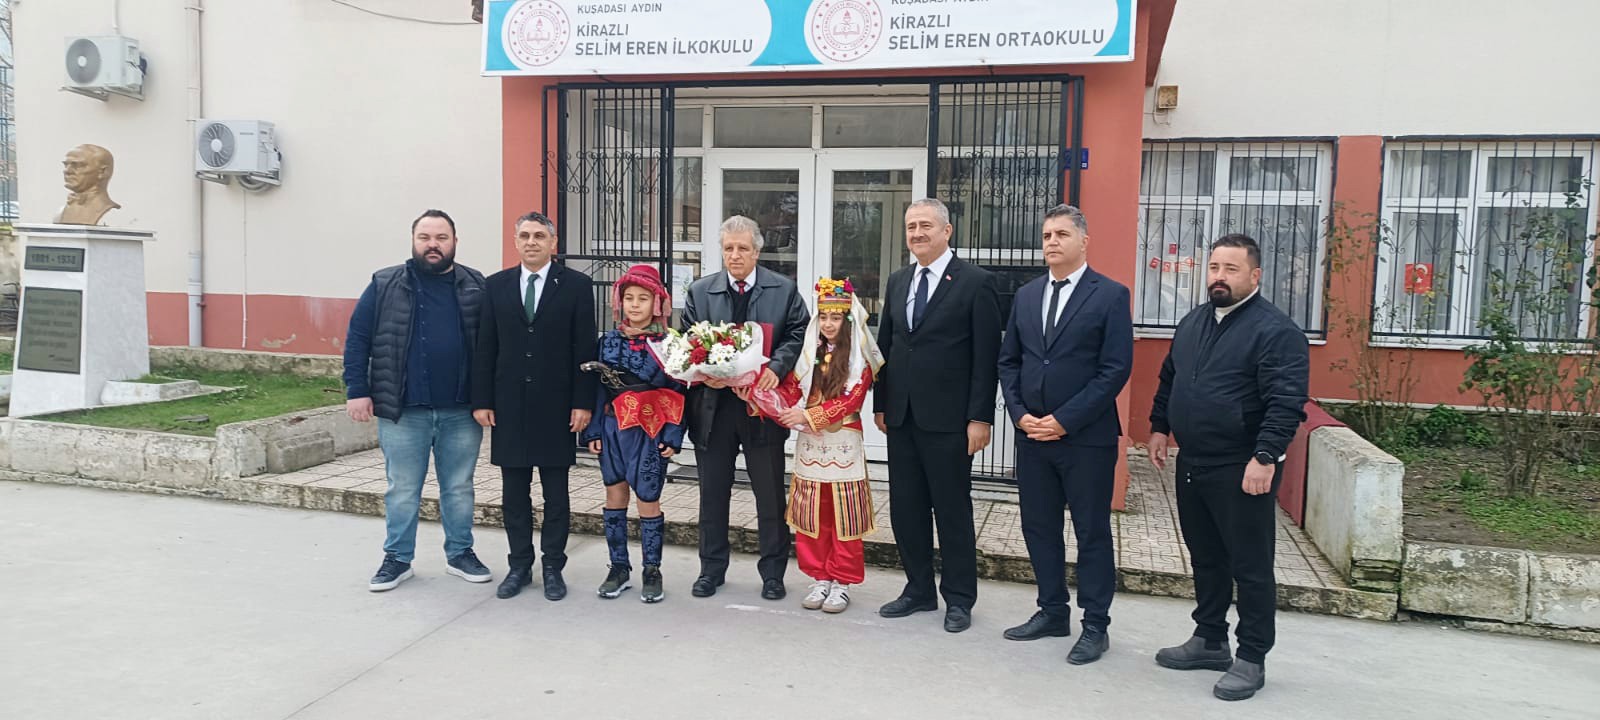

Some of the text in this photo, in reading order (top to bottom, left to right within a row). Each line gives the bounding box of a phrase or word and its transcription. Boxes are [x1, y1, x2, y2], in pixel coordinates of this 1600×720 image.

[577, 3, 662, 14] KUŞADASI AYDIN
[890, 13, 951, 29] KİRAZLI
[576, 22, 629, 37] KİRAZLI
[575, 37, 753, 56] SELİM EREN İLKOKULU
[888, 29, 1105, 50] SELİM EREN ORTAOKULU
